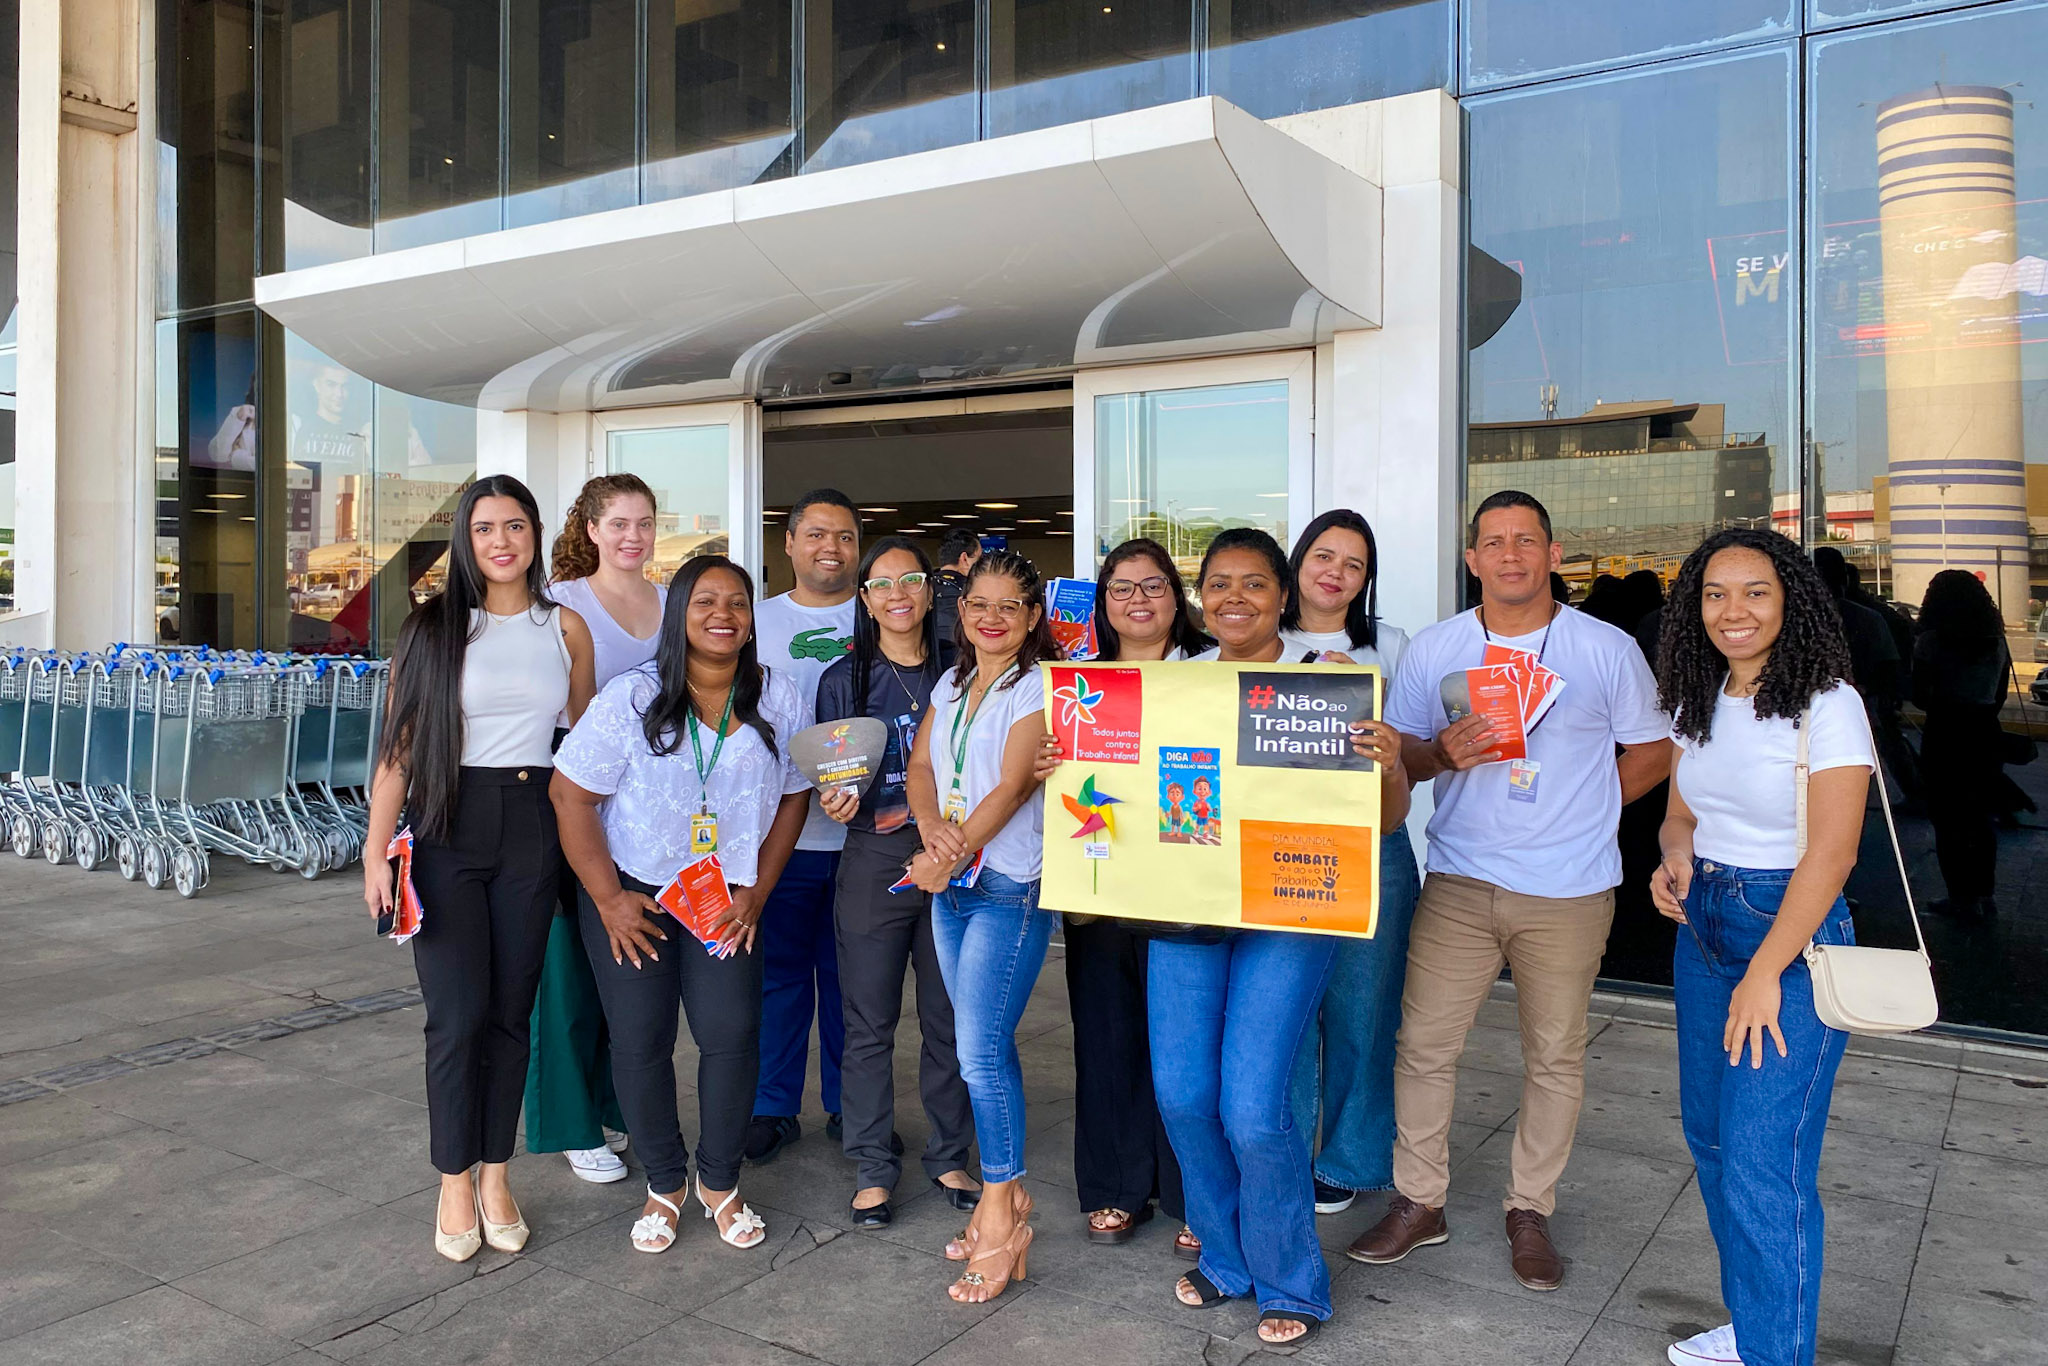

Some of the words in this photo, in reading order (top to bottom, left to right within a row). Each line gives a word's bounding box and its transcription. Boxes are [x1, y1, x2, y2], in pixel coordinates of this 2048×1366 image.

[1247, 685, 1328, 711] #Não
[1328, 703, 1348, 712] ao
[1091, 728, 1114, 737] Todos
[1116, 729, 1140, 739] juntos
[1105, 741, 1131, 749] contra
[1255, 736, 1345, 756] Infantil
[1078, 750, 1111, 759] Trabalho
[1166, 752, 1189, 762] DIGA
[1191, 750, 1213, 763] NÃO
[1272, 834, 1290, 844] DIA
[1292, 835, 1340, 847] MUNDIAL
[1273, 852, 1339, 867] COMBATE
[1294, 867, 1306, 875] ao
[1271, 873, 1318, 888] Trabalho
[1273, 886, 1338, 902] INFANTIL
